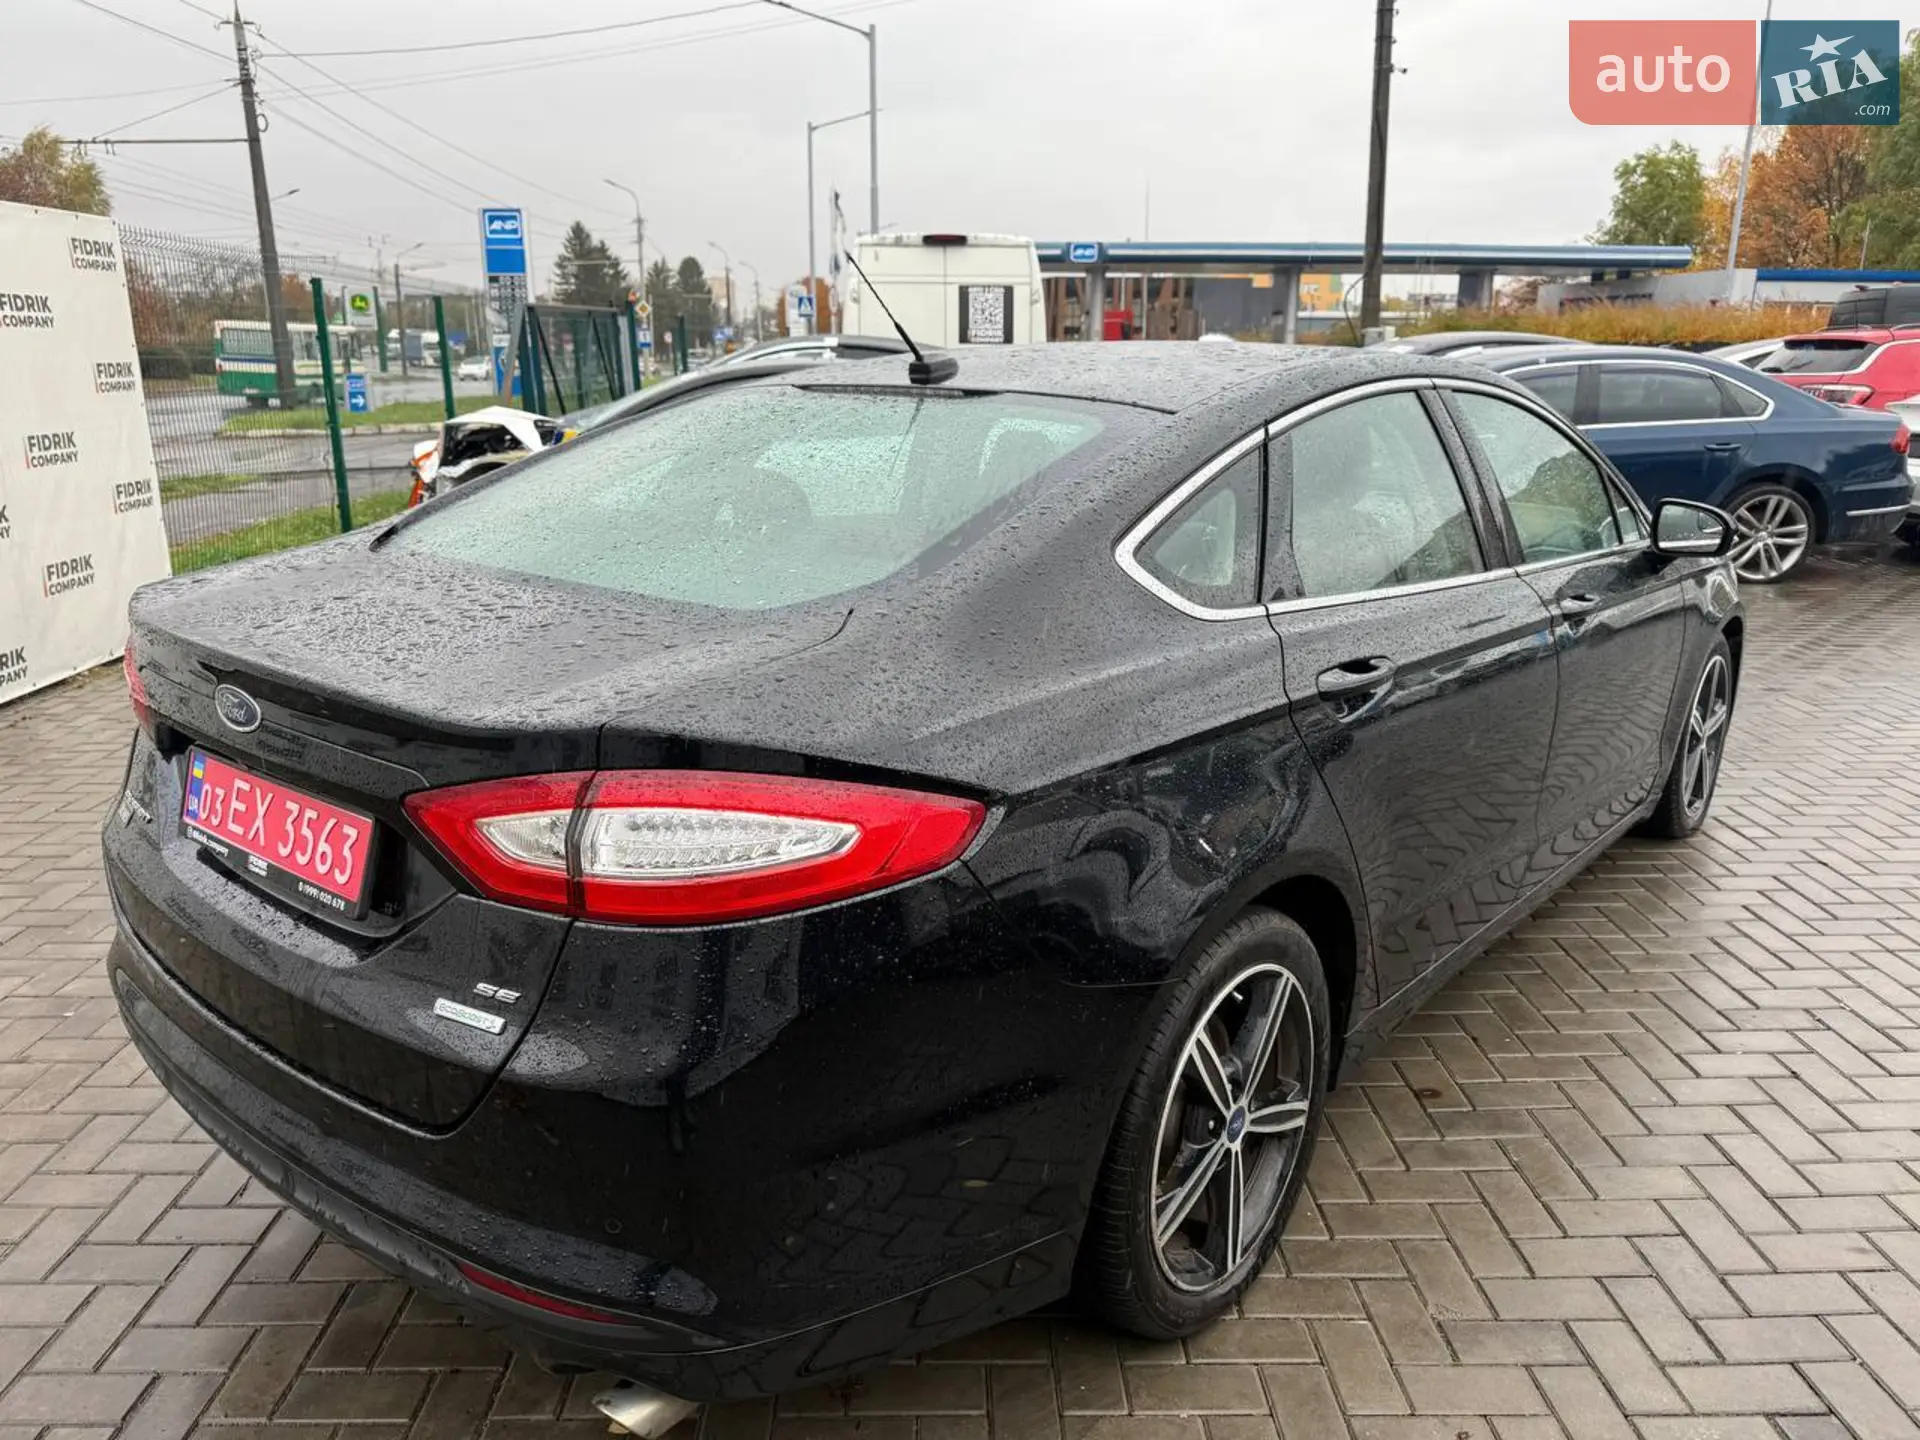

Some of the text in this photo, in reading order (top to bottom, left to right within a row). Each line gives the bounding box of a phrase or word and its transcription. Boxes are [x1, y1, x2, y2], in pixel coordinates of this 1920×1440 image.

[71, 237, 115, 259] FIDRIK
[75, 258, 117, 272] COMPANY
[0, 293, 52, 313] FIDRIK
[2, 315, 54, 328] COMPANY
[96, 361, 135, 379] FIDRIK
[99, 381, 136, 394] COMPANY
[27, 432, 77, 453] FIDRIK
[31, 451, 78, 469] COMPANY
[47, 554, 94, 582] FIDRIK
[49, 572, 95, 596] COMPANY
[221, 692, 248, 723] Ford
[200, 783, 227, 828] 03
[227, 778, 275, 847] EX
[277, 800, 359, 885] 3563
[473, 983, 522, 1003] SE
